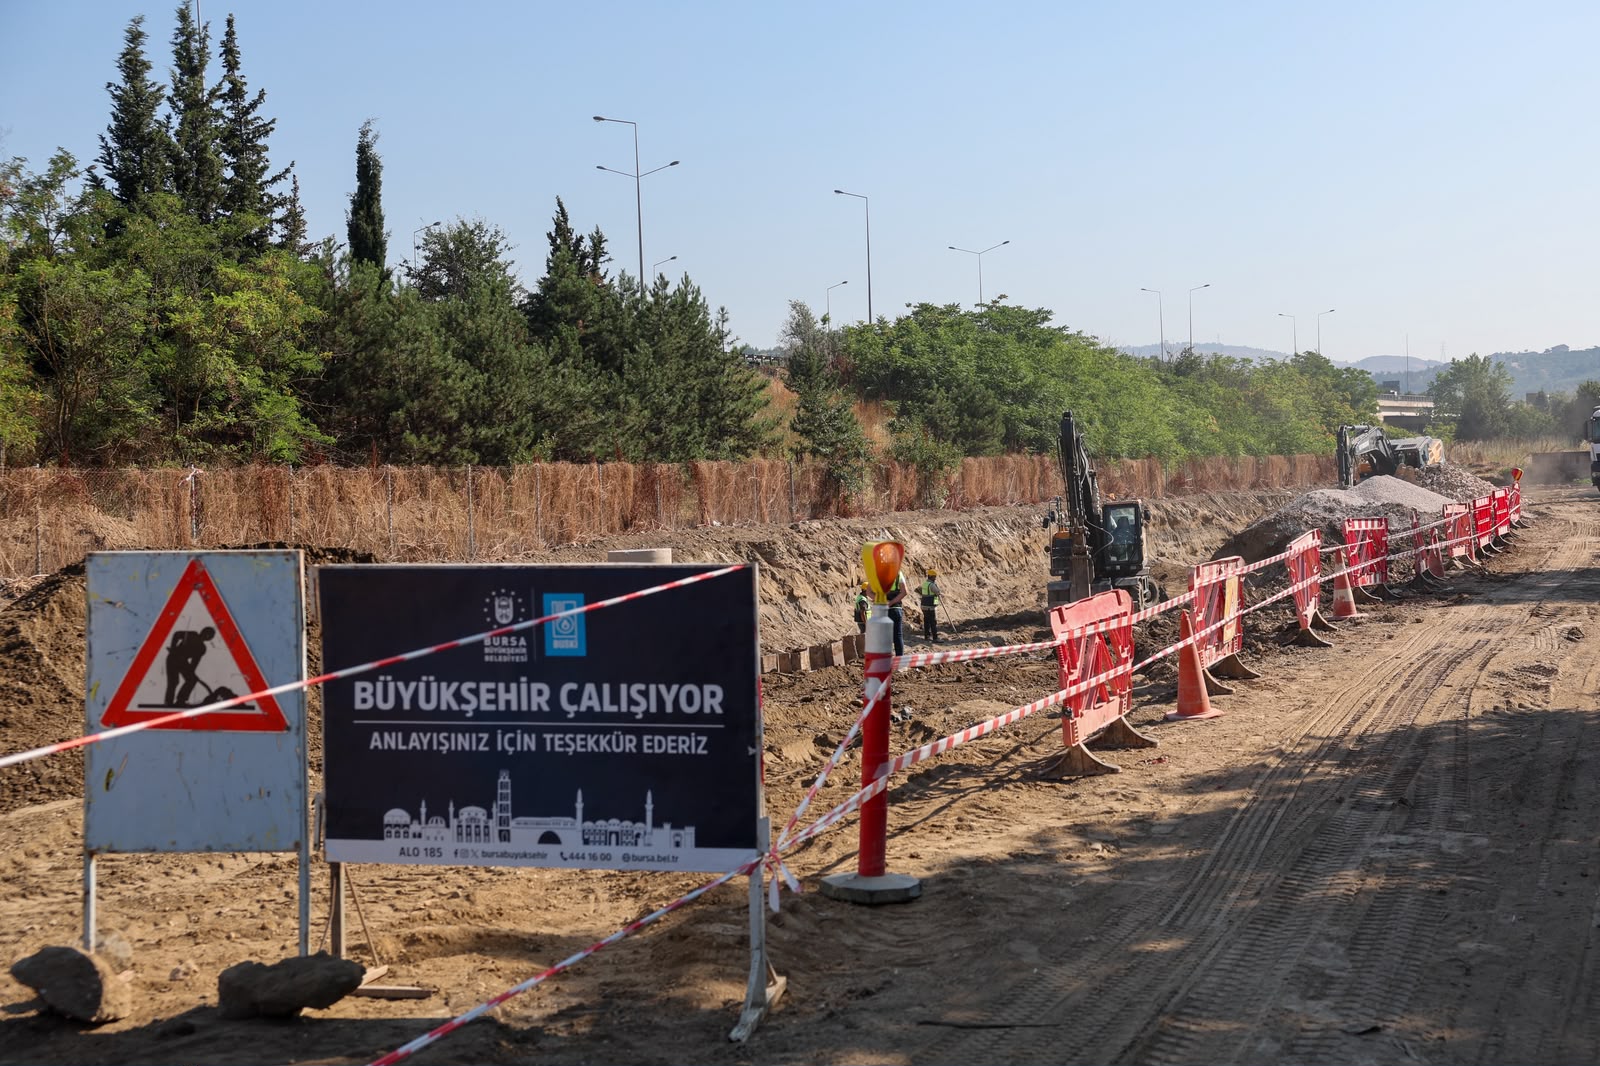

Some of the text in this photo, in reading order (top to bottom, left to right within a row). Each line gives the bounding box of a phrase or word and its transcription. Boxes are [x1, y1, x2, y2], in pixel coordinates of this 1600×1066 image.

[483, 636, 527, 646] BURSA
[353, 675, 724, 719] BÜYÜKŞEHİR ÇALIŞIYOR
[369, 730, 708, 755] ANLAYIŞINIZ İÇİN TEŞEKKÜR EDERİZ
[399, 847, 443, 858] ALO 185
[569, 852, 612, 862] 444 16 00
